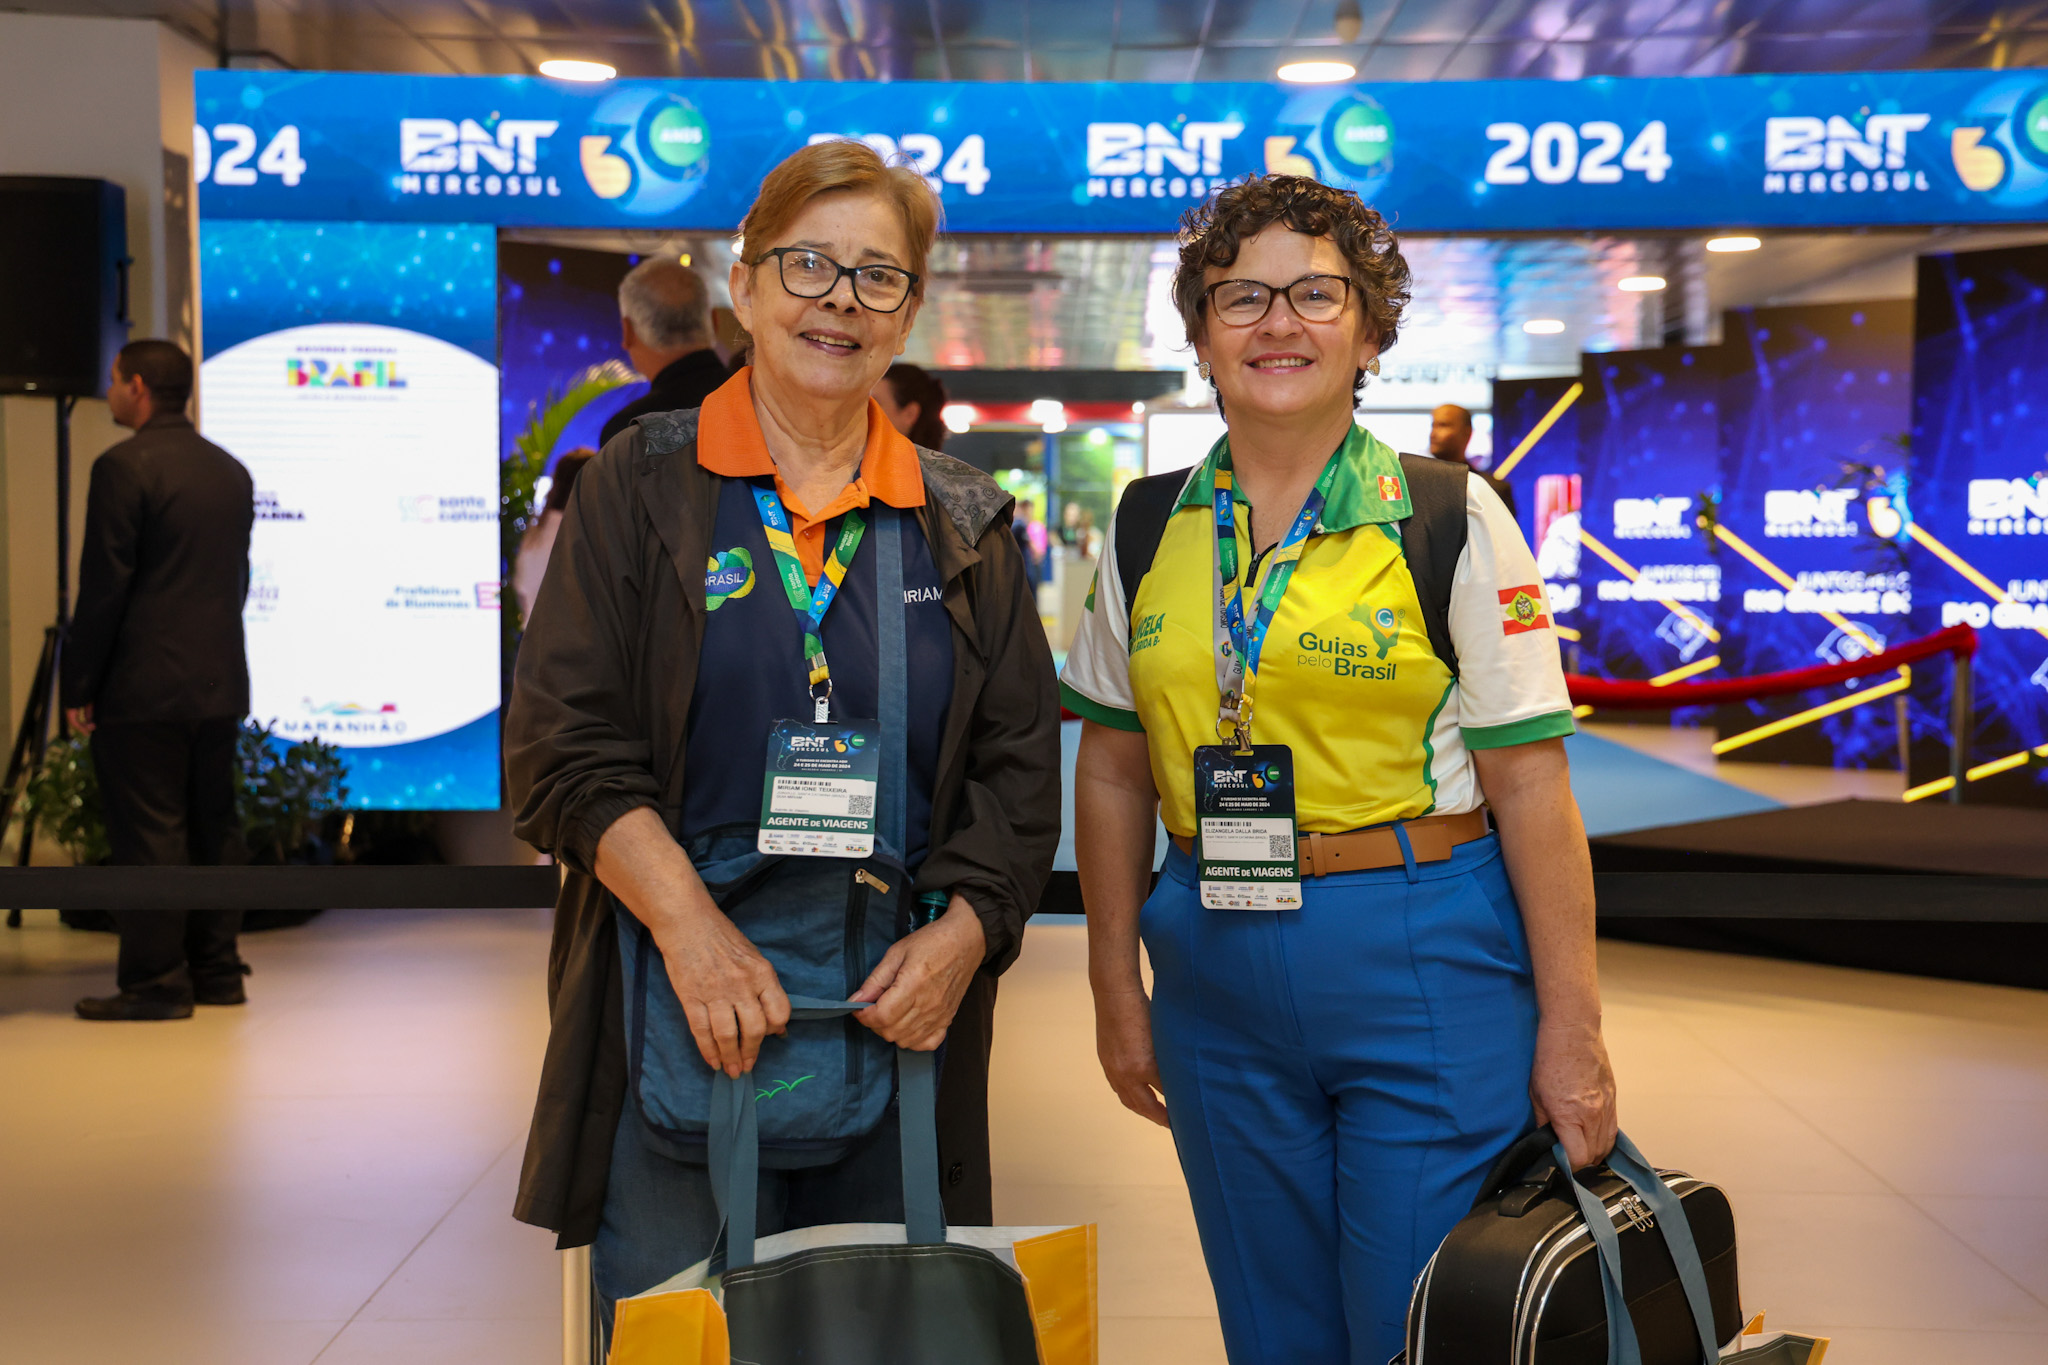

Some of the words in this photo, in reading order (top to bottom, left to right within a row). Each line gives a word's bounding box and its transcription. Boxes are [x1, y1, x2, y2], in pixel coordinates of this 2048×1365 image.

[400, 118, 560, 174] BNT
[1087, 121, 1245, 176] BNT
[1485, 120, 1672, 184] 2024
[1764, 113, 1931, 171] BNT
[807, 133, 991, 196] 24
[400, 176, 561, 196] MERCOSUL
[1763, 171, 1930, 194] MERCOSUL
[286, 359, 407, 388] BRASIL
[903, 586, 943, 604] IRIAM
[1298, 631, 1368, 658] Guias
[1297, 654, 1332, 668] pelo
[1334, 657, 1397, 680] Brasil
[790, 736, 830, 747] BNT
[1213, 770, 1248, 783] BNT
[766, 817, 809, 827] AGENTE
[822, 819, 868, 829] VIAGENS
[1205, 866, 1240, 877] AGENTE
[1241, 868, 1251, 877] DE
[1251, 867, 1294, 877] VIAGENS
